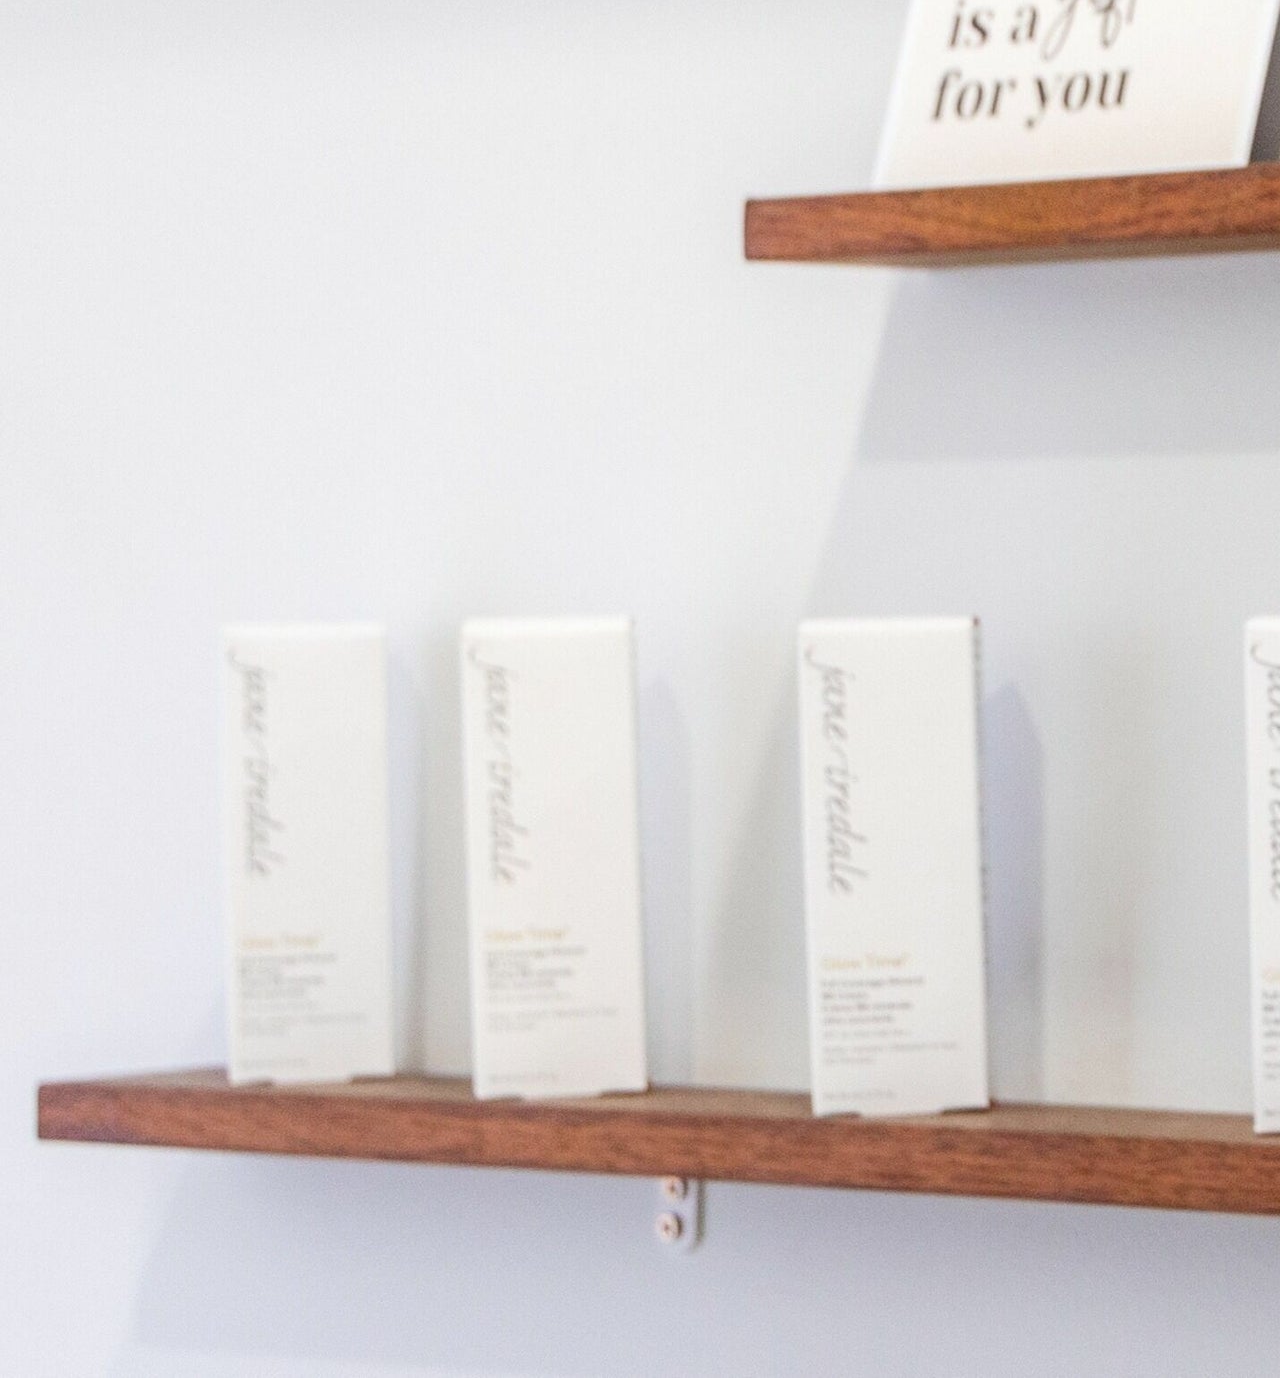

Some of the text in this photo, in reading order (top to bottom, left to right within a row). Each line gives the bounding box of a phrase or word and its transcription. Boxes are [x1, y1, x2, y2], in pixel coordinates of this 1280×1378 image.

[1008, 4, 1040, 45] a
[930, 66, 1131, 130] for you
